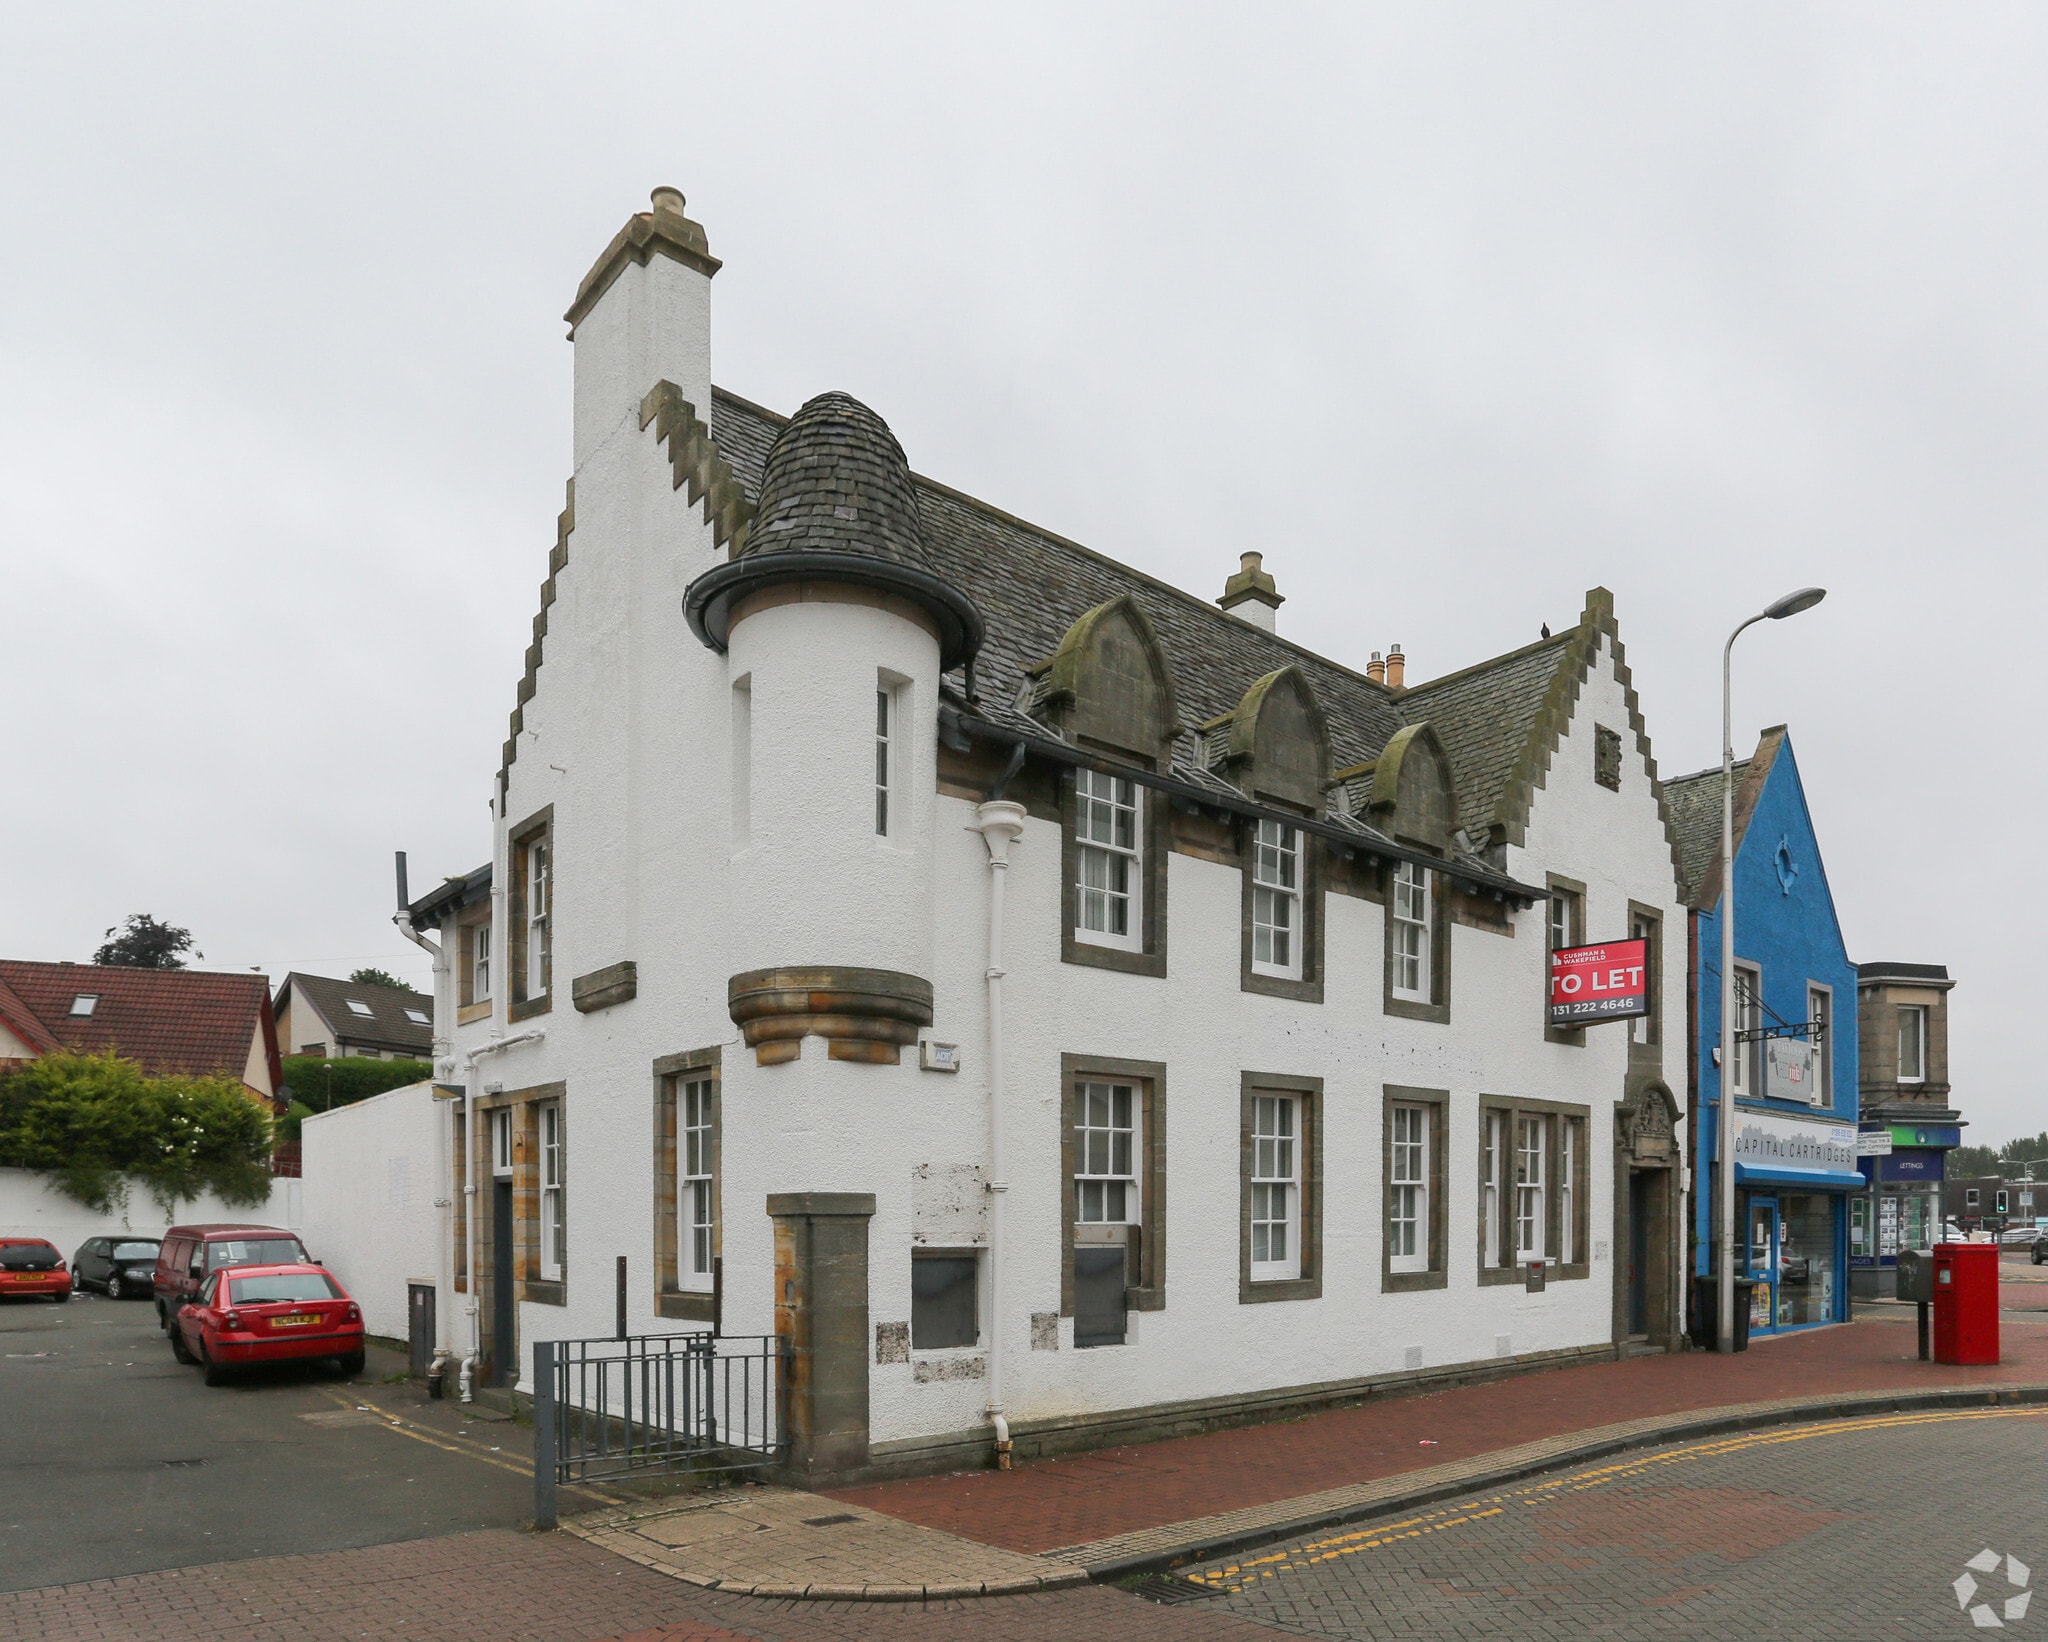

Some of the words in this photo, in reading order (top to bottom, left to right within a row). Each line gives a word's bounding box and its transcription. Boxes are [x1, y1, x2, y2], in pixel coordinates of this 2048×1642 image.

[1563, 950, 1599, 960] CUSHMAN
[1563, 955, 1606, 965] WAKEFIELD
[1551, 974, 1582, 996] TO
[1592, 966, 1643, 991] LET
[1573, 1002, 1597, 1014] 222
[1600, 997, 1634, 1010] 4646
[936, 1051, 951, 1062] ADT
[1735, 1137, 1784, 1157] CAPITAL
[1789, 1143, 1851, 1163] CARTRIDGES
[275, 1317, 298, 1325] NC04
[300, 1315, 316, 1323] KJF
